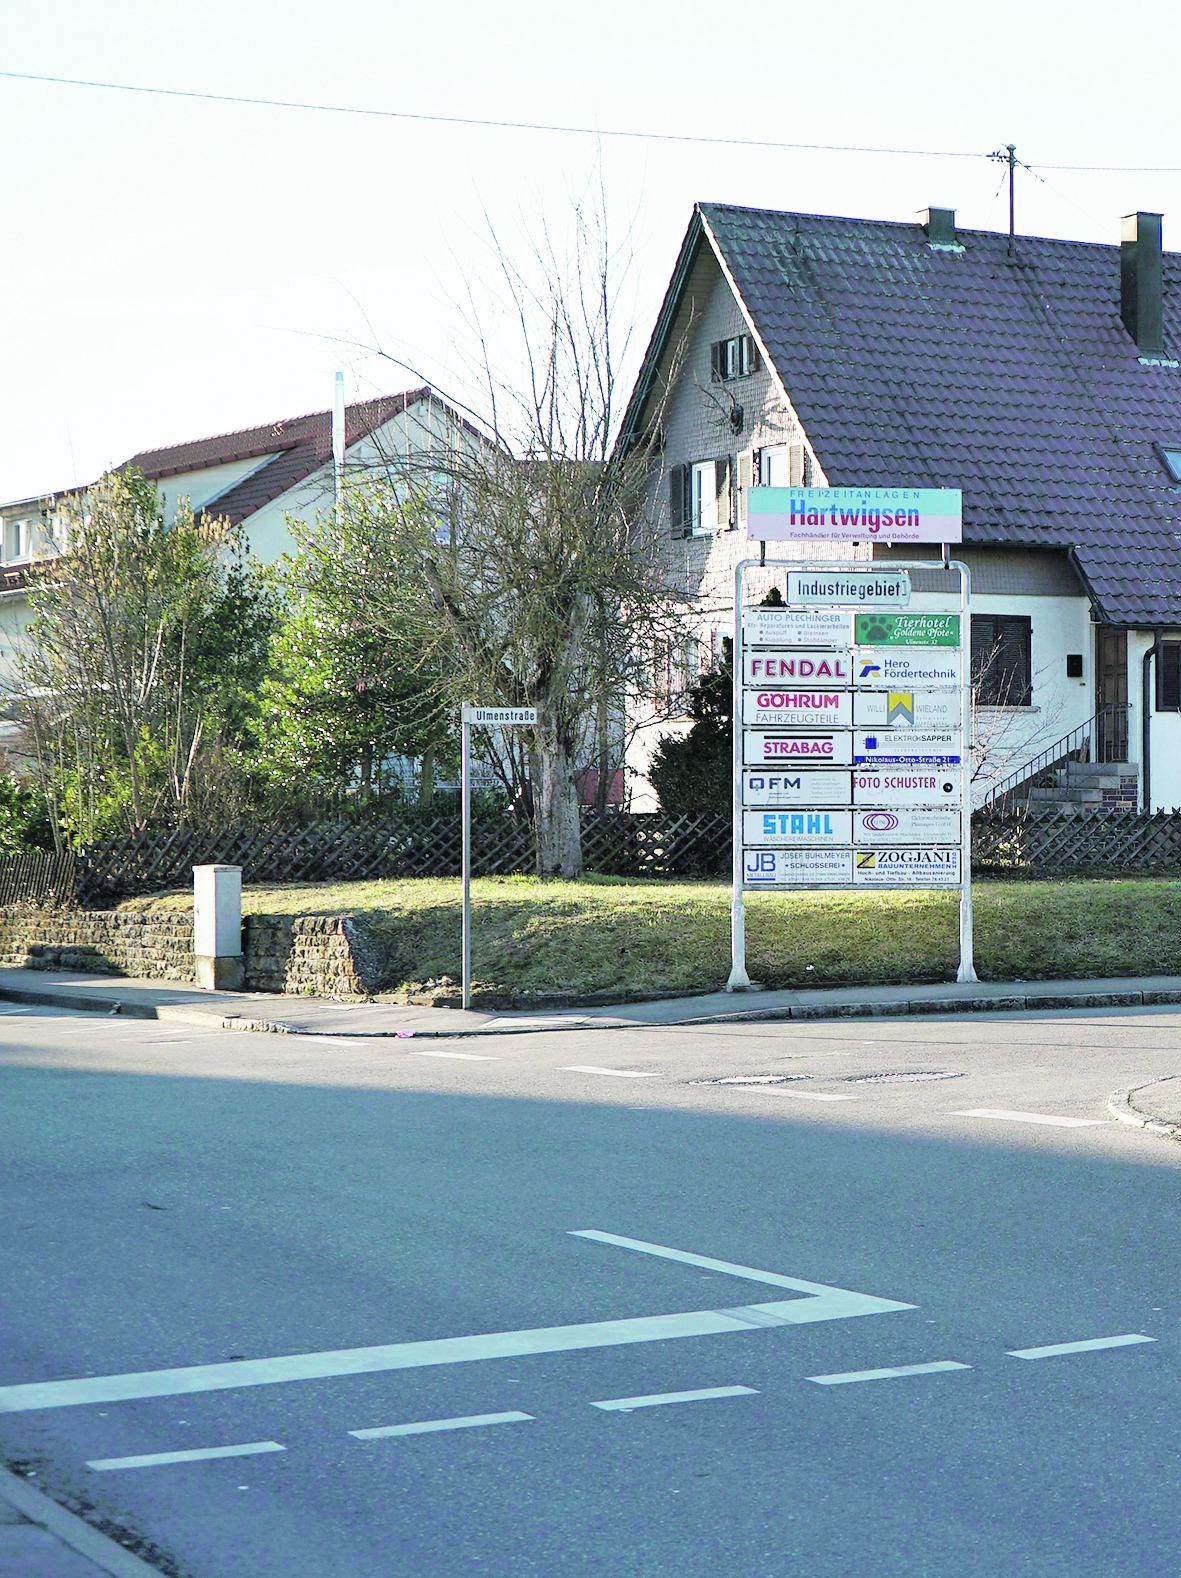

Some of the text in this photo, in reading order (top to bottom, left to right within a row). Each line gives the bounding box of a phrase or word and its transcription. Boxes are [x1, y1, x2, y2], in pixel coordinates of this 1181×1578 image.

[790, 490, 920, 499] FREIZEITANLAGEN
[790, 499, 919, 533] Hartwigsen
[798, 580, 900, 600] Industriegebiet
[786, 614, 841, 622] PLECHINGER
[895, 616, 952, 628] Tierhotel
[751, 659, 847, 677] FENDAL
[884, 660, 910, 668] Hero
[884, 669, 956, 679] Fördertechnik
[757, 693, 839, 709] GÖHRUM
[916, 705, 948, 713] WIELAND
[476, 711, 534, 720] Ulmenstraße
[756, 713, 839, 723] FAHRZEUGTEILE
[764, 742, 834, 754] STRABAG
[749, 777, 801, 792] QFM
[853, 777, 936, 788] FOTO SCHUSTER
[763, 814, 833, 834] STAHL
[747, 853, 776, 872] JB
[878, 851, 951, 863] ZOGJANI
